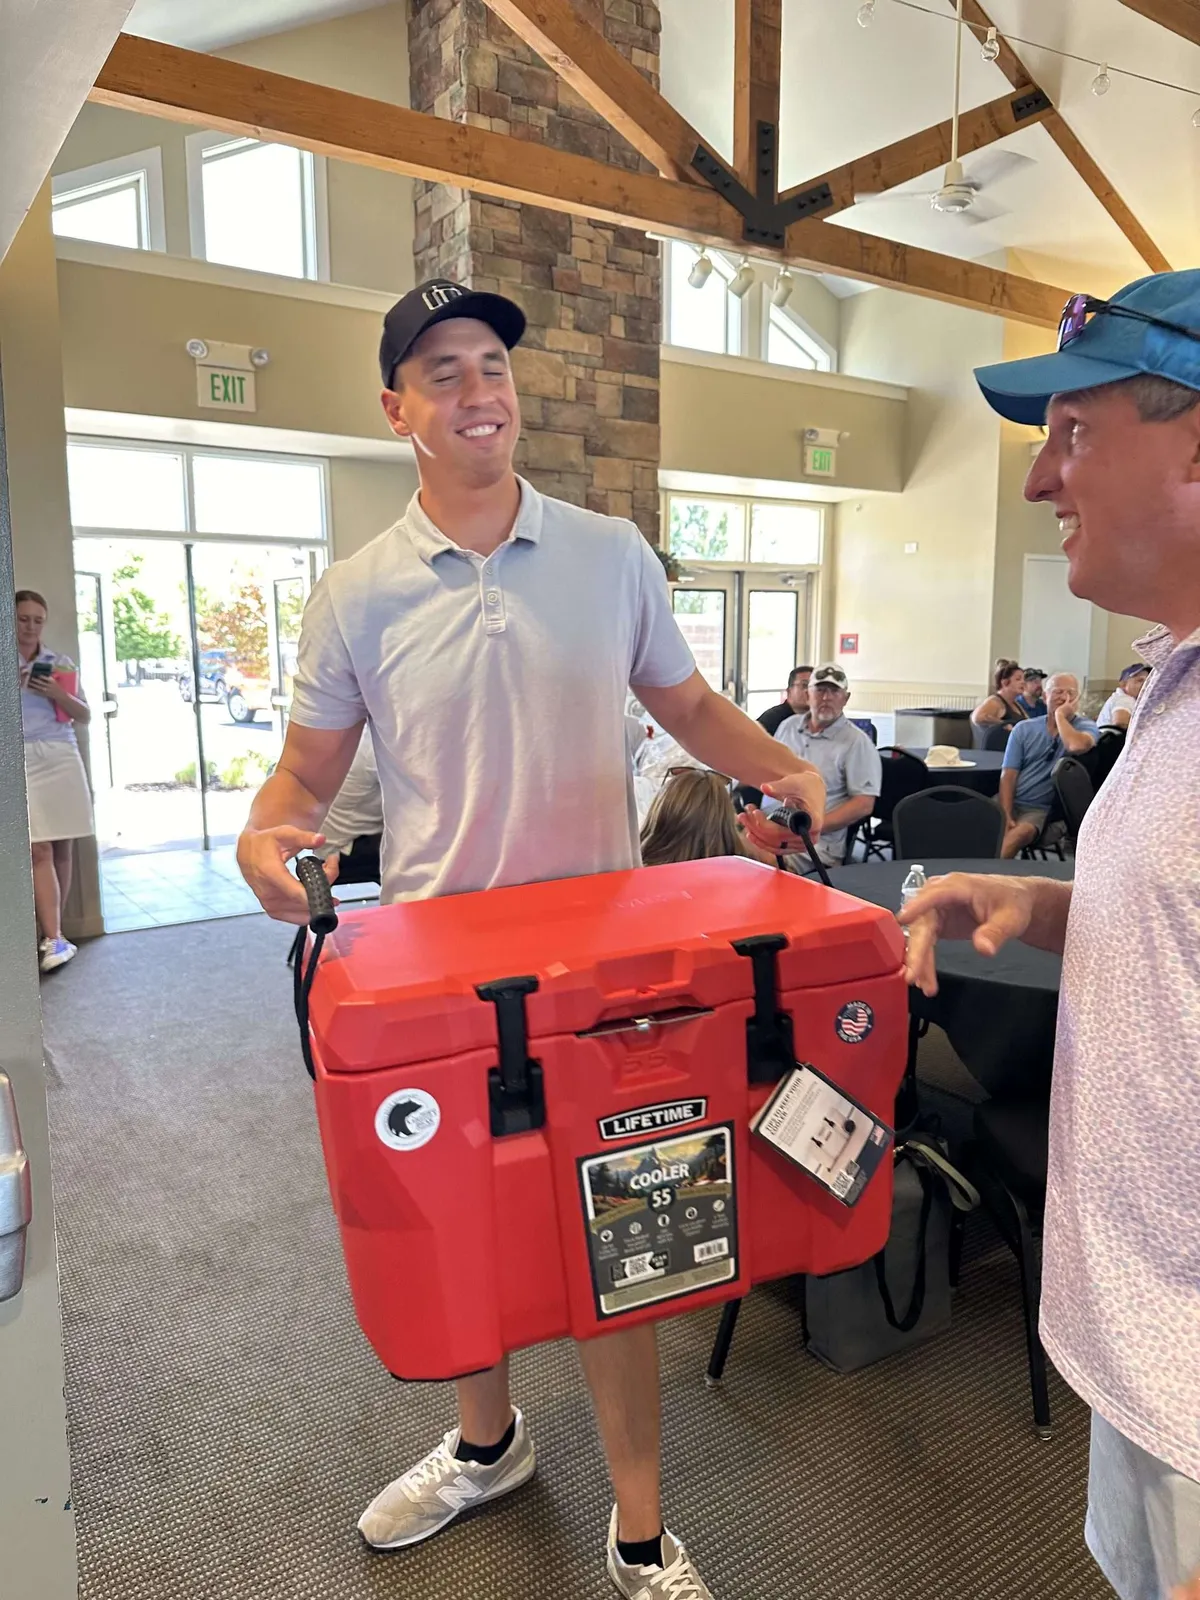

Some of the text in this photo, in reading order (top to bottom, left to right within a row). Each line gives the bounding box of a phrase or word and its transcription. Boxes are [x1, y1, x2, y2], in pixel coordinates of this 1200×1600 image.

[210, 373, 246, 404] EXIT
[812, 449, 832, 472] EXIT
[625, 1053, 667, 1074] 55
[613, 1104, 694, 1133] LIFETIME
[766, 1117, 777, 1132] TIPS
[780, 1094, 791, 1109] KEEP
[789, 1077, 802, 1093] YOUR
[630, 1163, 690, 1190] COOLER
[651, 1188, 672, 1208] 55
[436, 1475, 484, 1509] N
